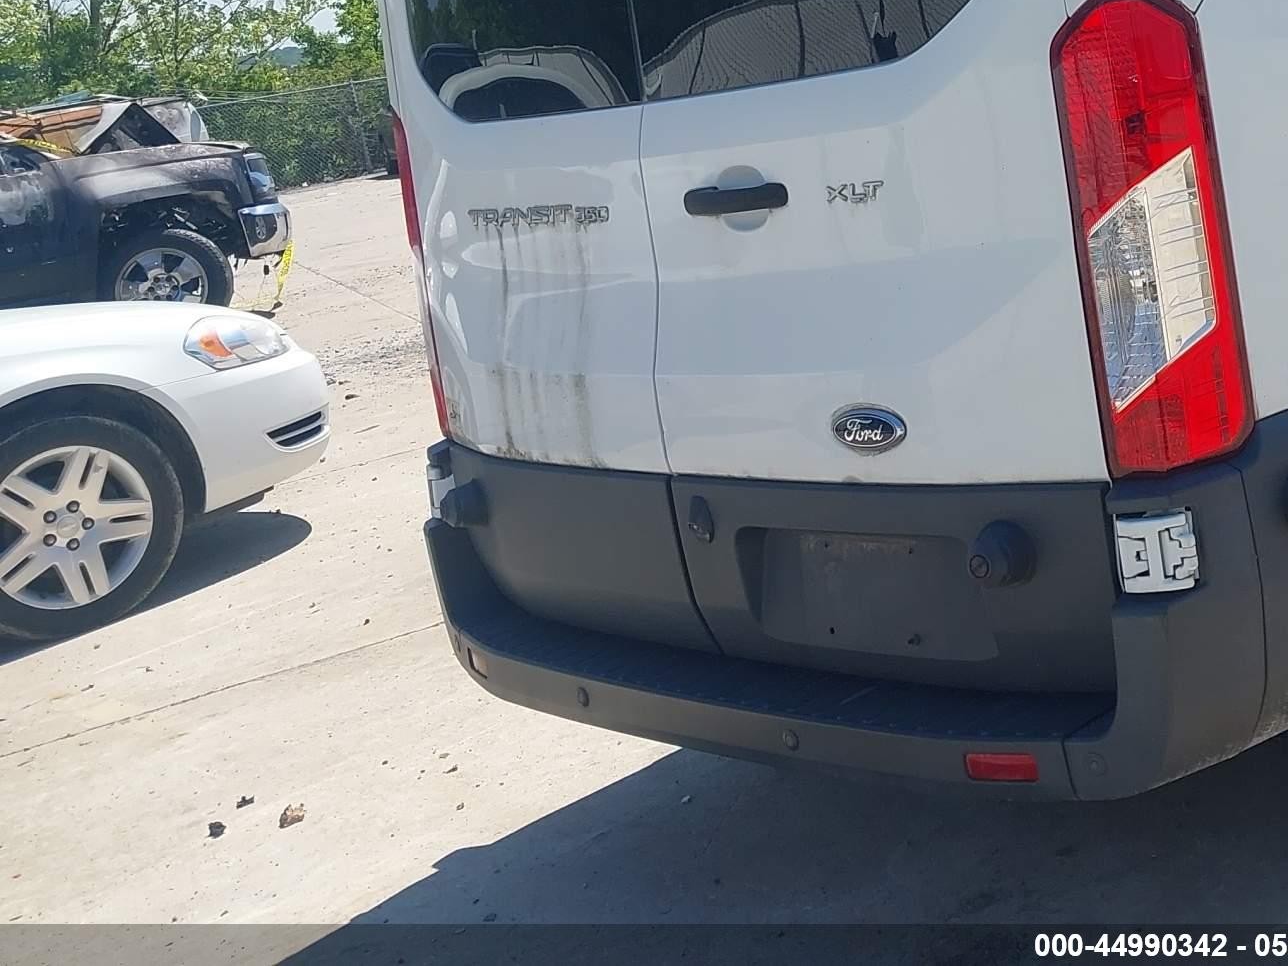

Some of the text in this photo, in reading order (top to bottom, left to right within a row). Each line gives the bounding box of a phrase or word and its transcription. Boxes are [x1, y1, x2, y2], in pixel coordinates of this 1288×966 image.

[825, 180, 884, 203] XLT
[467, 204, 573, 227] TRANSIT
[844, 418, 884, 441] Ford
